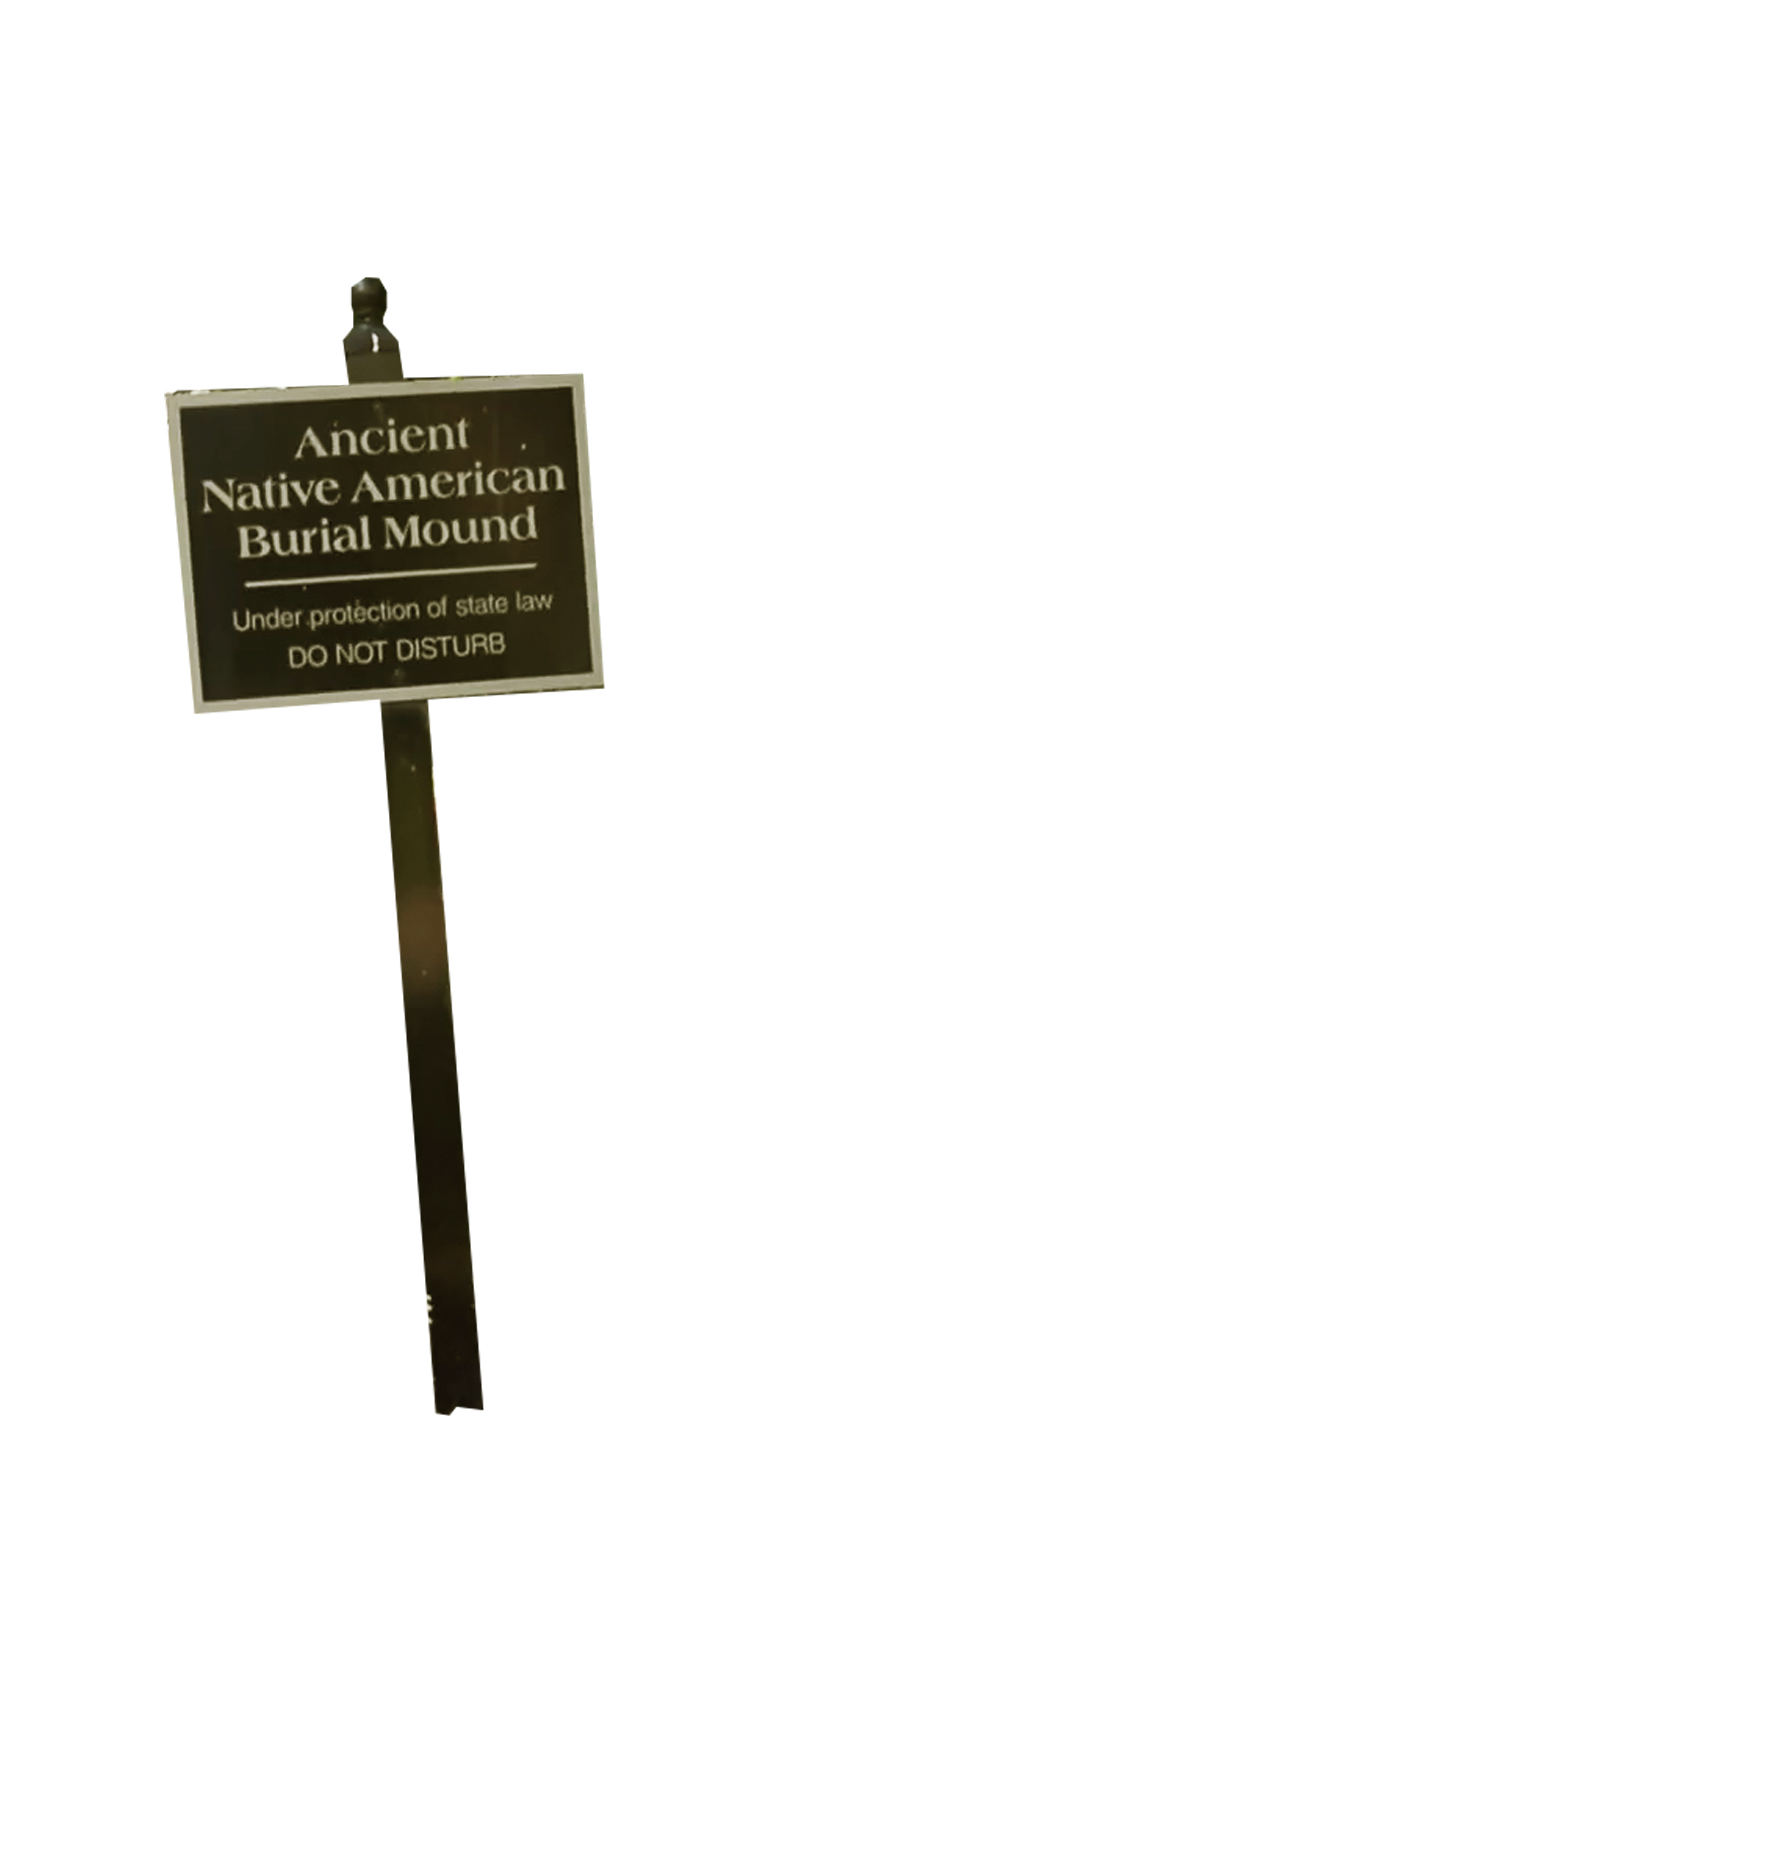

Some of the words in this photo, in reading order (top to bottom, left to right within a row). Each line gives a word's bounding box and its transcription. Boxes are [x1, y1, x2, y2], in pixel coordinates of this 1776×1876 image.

[294, 417, 470, 460] Ancient
[201, 472, 341, 513] Native
[351, 460, 566, 504] American
[238, 515, 372, 559] Burial
[384, 506, 539, 550] Mound
[232, 607, 301, 631] Under
[310, 601, 420, 631] protection
[427, 596, 446, 617] of
[456, 596, 508, 616] state
[515, 591, 553, 611] law
[289, 644, 327, 668] DO
[336, 641, 387, 664] NOT
[397, 632, 506, 661] DISTURB
